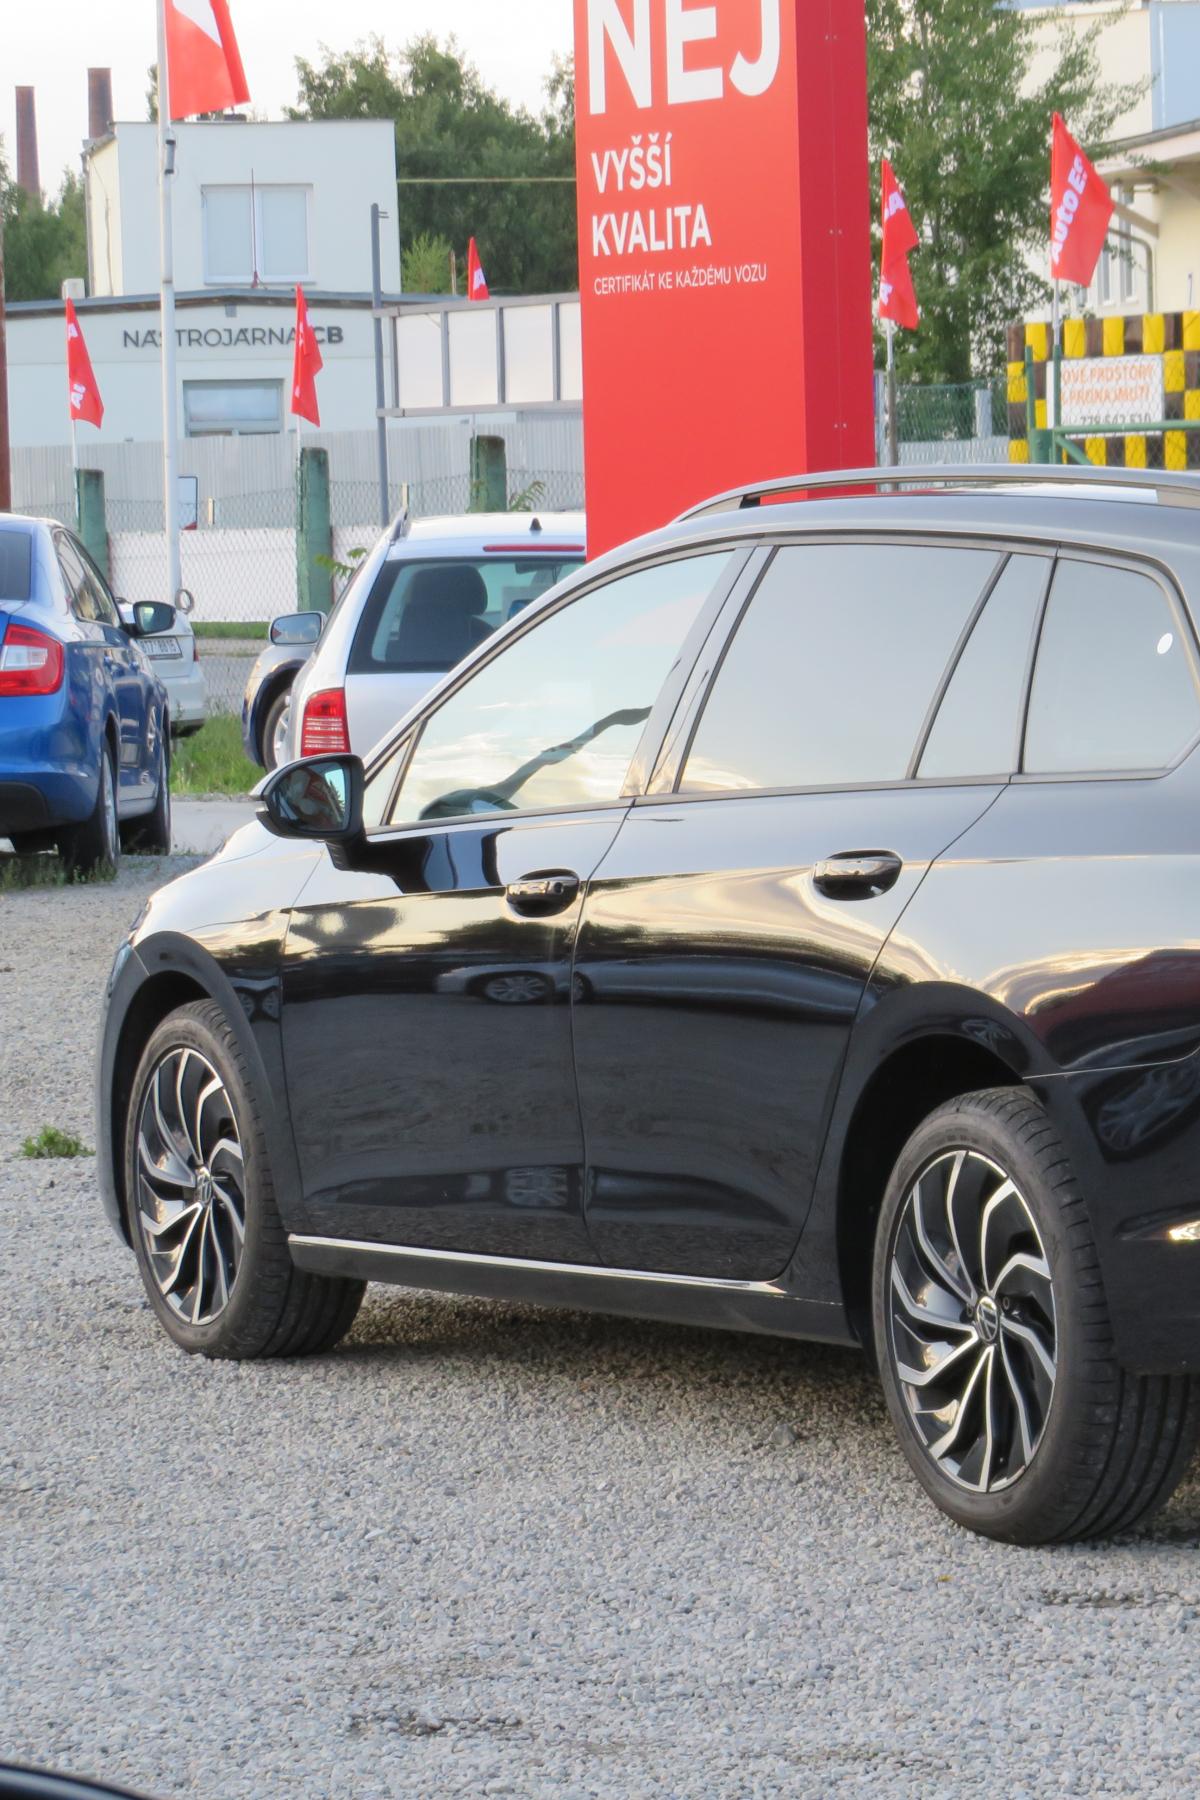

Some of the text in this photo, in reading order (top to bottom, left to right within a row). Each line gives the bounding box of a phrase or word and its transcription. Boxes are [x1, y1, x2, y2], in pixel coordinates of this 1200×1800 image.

[587, 0, 780, 115] NEJ
[591, 132, 672, 193] VYŠŠÍ
[592, 204, 712, 257] KVALITA
[594, 264, 767, 295] CERTIFIKÁT KE KAŽDÉMU VOZU
[123, 327, 297, 347] NÁTROJÁRNA
